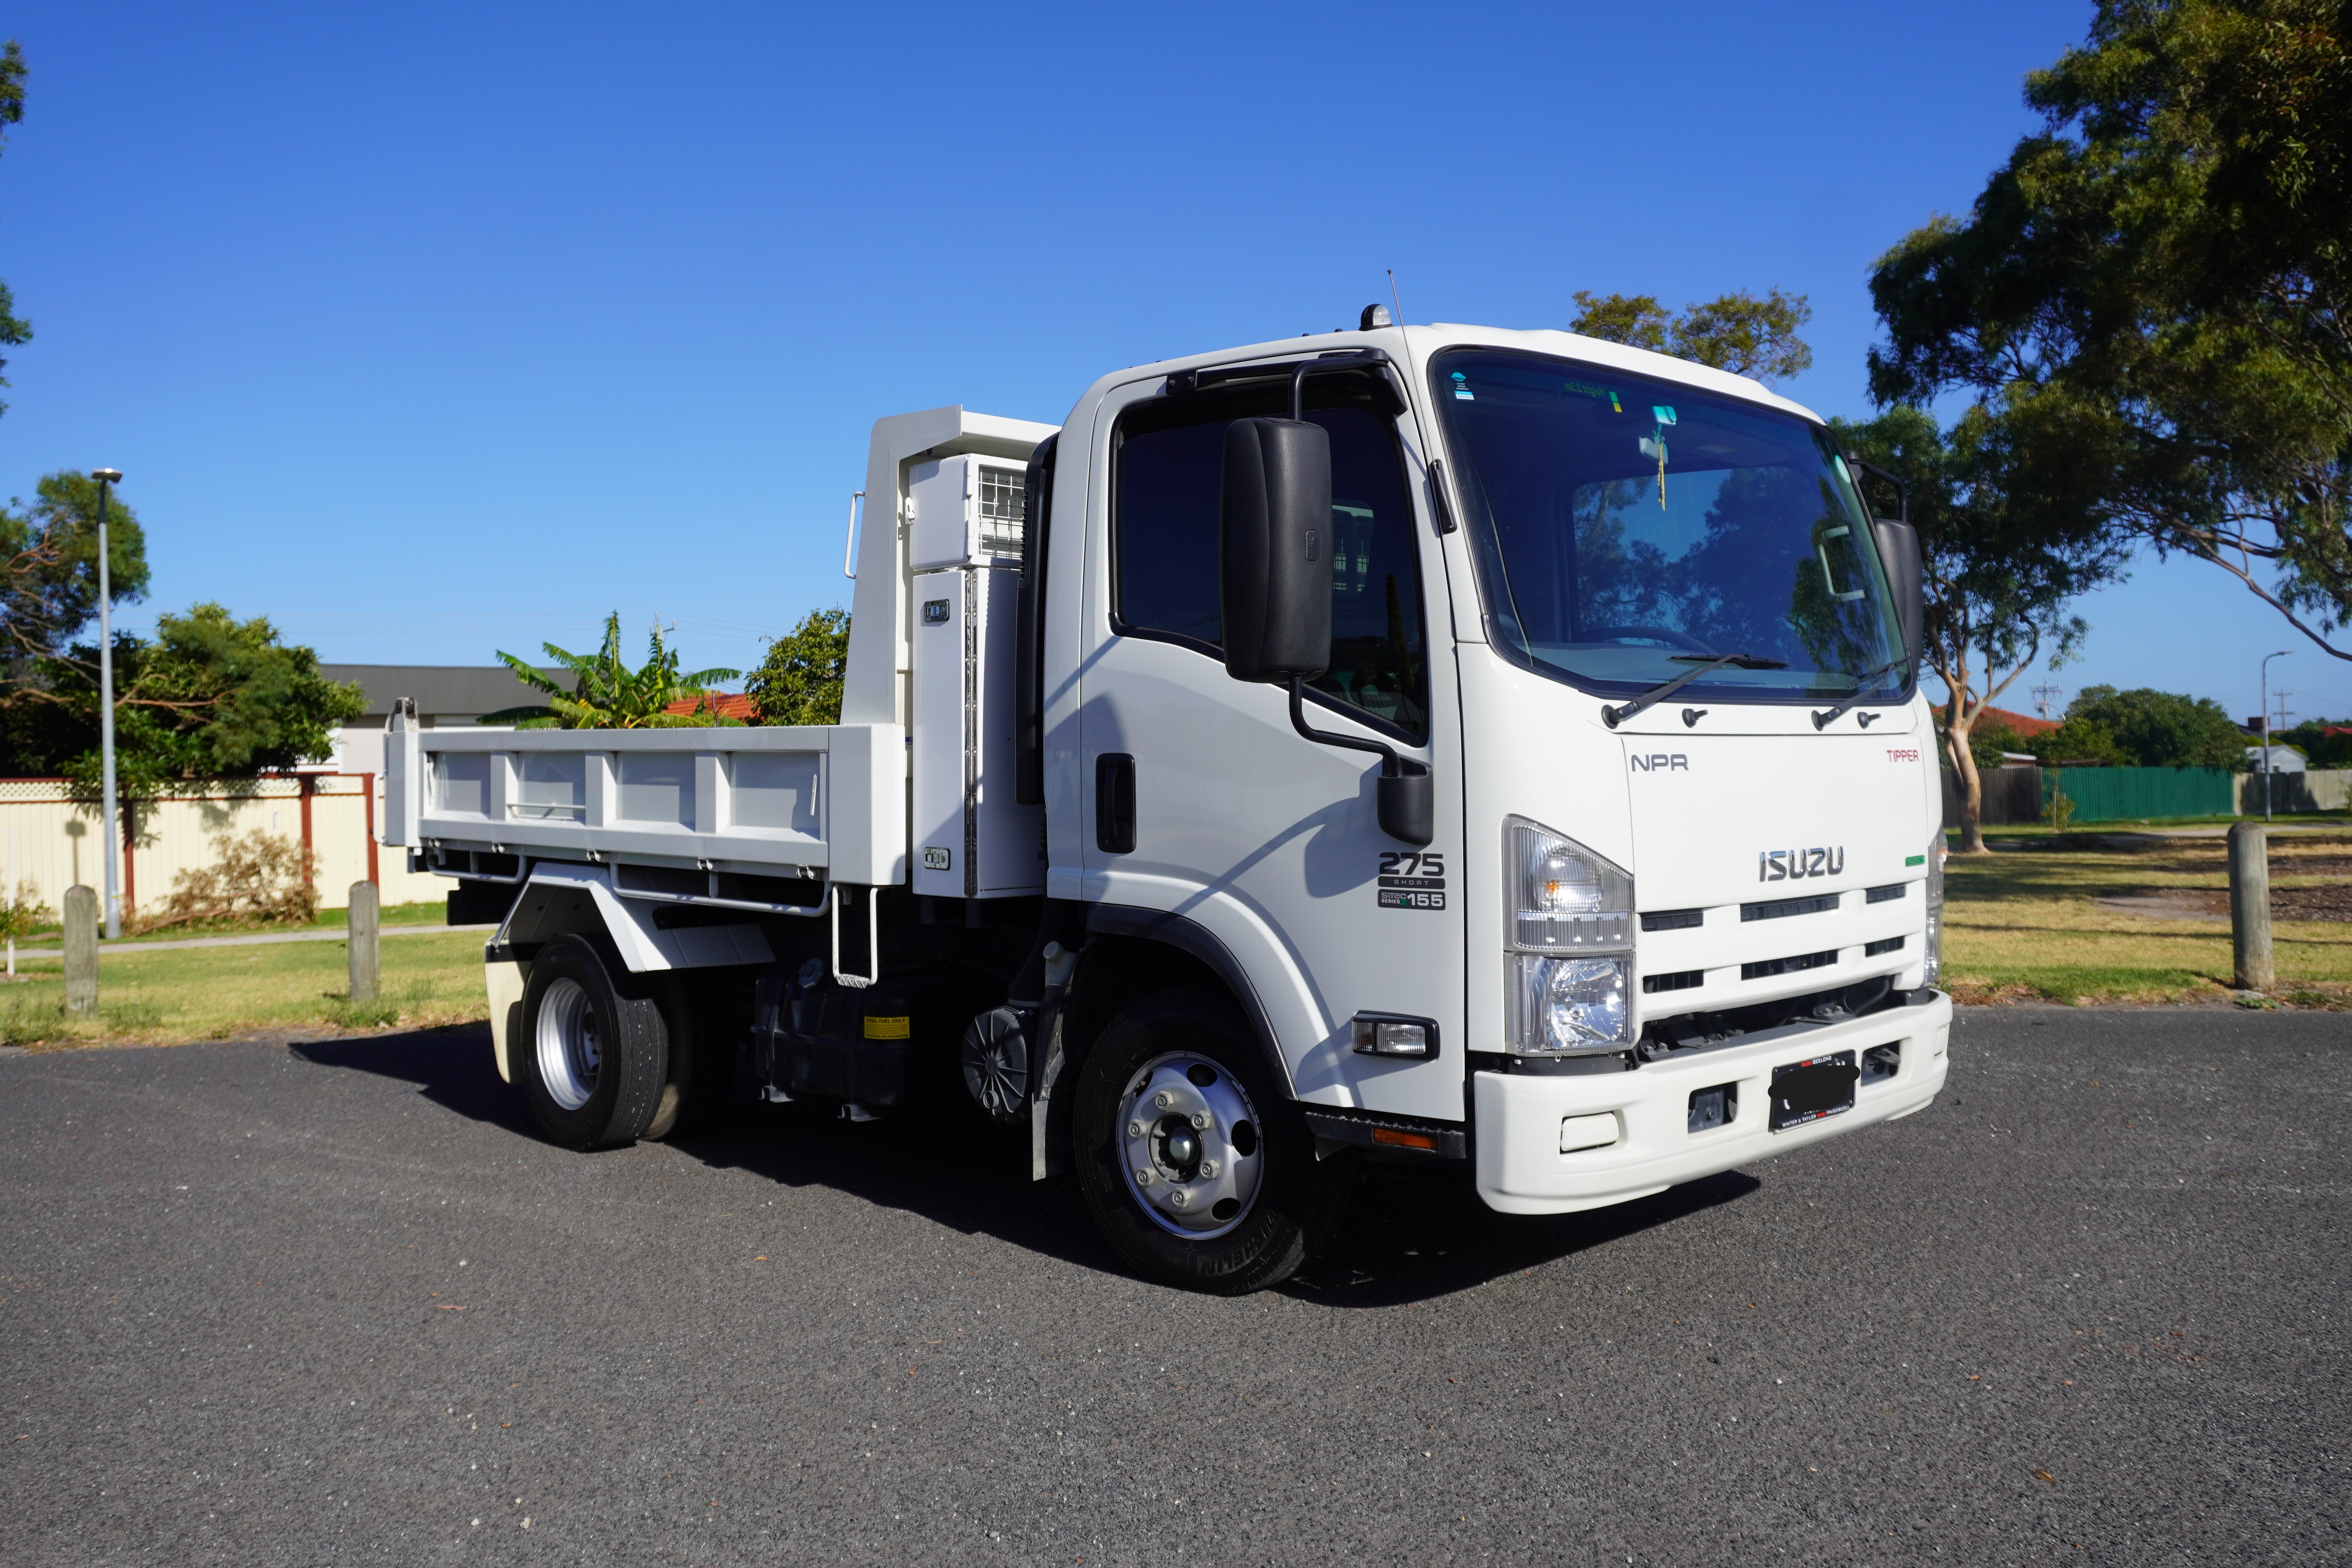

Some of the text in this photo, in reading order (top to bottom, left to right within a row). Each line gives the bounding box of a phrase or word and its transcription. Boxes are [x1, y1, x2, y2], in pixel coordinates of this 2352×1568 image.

[1631, 754, 1689, 772] NPR
[1887, 750, 1920, 762] TIPPER
[1379, 852, 1445, 877] 275
[1759, 846, 1844, 883] ISUZU
[1407, 893, 1443, 907] 155
[1813, 1056, 1831, 1065] GEELONG
